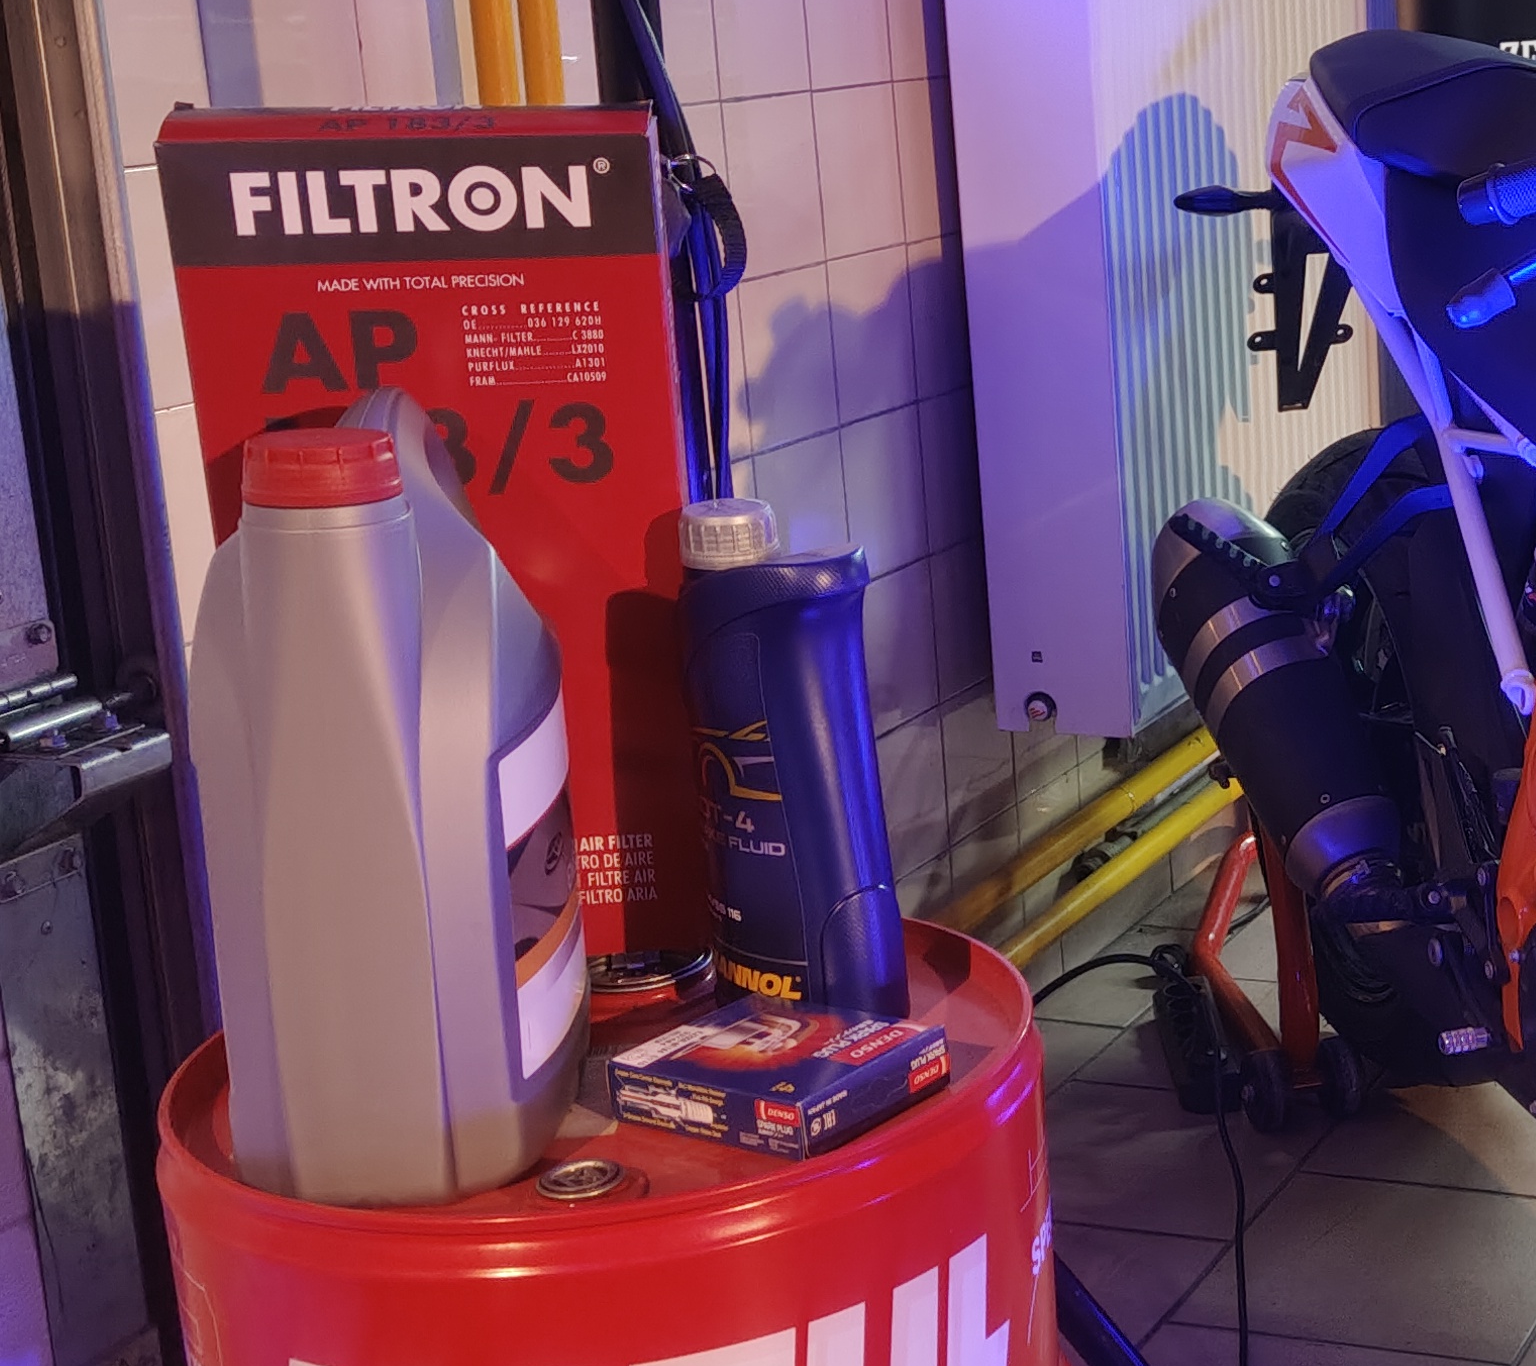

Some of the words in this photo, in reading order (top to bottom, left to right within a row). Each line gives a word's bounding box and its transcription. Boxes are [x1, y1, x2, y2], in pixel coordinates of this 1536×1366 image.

[229, 165, 592, 237] FILTRON
[317, 277, 360, 293] MADE
[362, 276, 403, 291] WITH
[405, 275, 448, 290] TOTAL
[452, 273, 525, 288] PRECISION
[461, 304, 506, 316] CROSS
[520, 300, 600, 315] REFERENCE
[463, 319, 477, 331] OE
[527, 317, 547, 328] 036
[551, 316, 570, 328] 129
[501, 331, 534, 344] FILTER
[262, 310, 419, 393] AP
[466, 345, 542, 358] KNECHT/MAHLE
[468, 360, 515, 373] PURFLUX
[575, 357, 606, 369] A1301
[469, 375, 496, 387] FRAM
[580, 836, 605, 852] AIR
[608, 833, 654, 851] FILTER
[728, 835, 787, 857] FLUID
[603, 852, 621, 868] DE
[625, 850, 655, 866] AIRE
[587, 869, 631, 887] FILTRE
[634, 868, 656, 884] AIR
[627, 886, 658, 902] ARIA
[850, 1029, 904, 1059] DENSO
[913, 1064, 939, 1085] DENSO
[767, 1108, 796, 1122] DENSO
